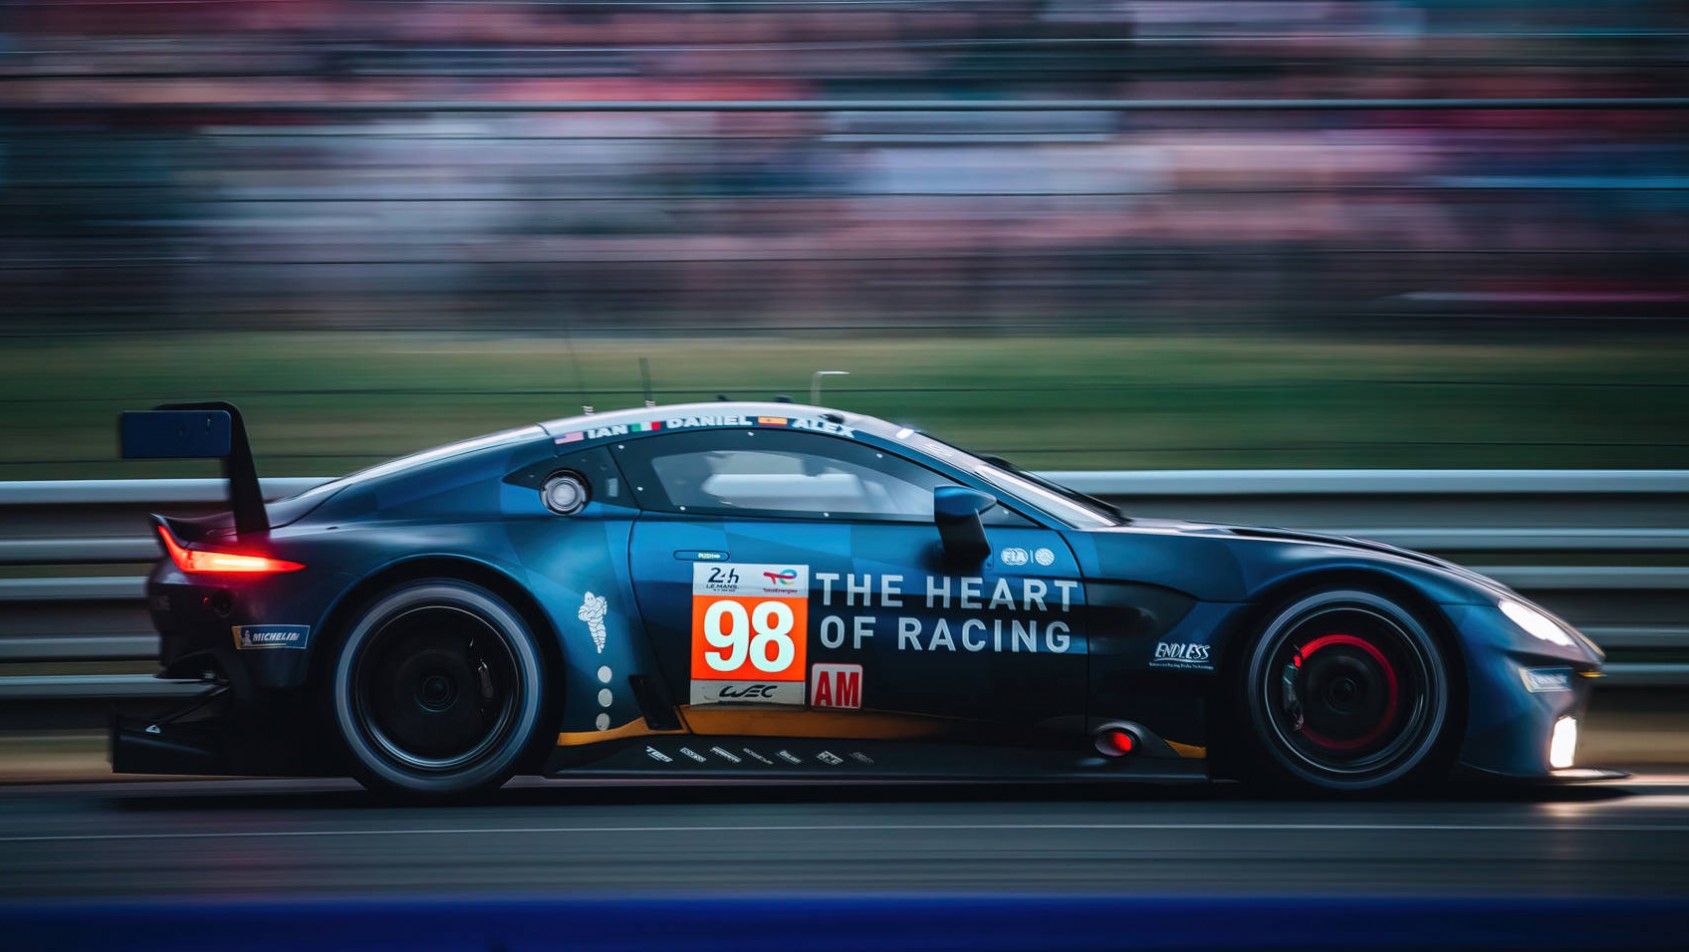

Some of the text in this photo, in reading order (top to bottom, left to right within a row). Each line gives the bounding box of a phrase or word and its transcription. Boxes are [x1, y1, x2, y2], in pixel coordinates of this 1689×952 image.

[587, 415, 855, 439] IAN DANIEL ALEX
[816, 573, 1078, 612] THE HEART
[253, 632, 300, 641] MICHELIN
[704, 600, 795, 673] 98
[820, 615, 1071, 653] OF RACING
[1155, 642, 1210, 659] ENDLESS
[719, 685, 778, 698] WEC
[814, 671, 860, 707] AM
